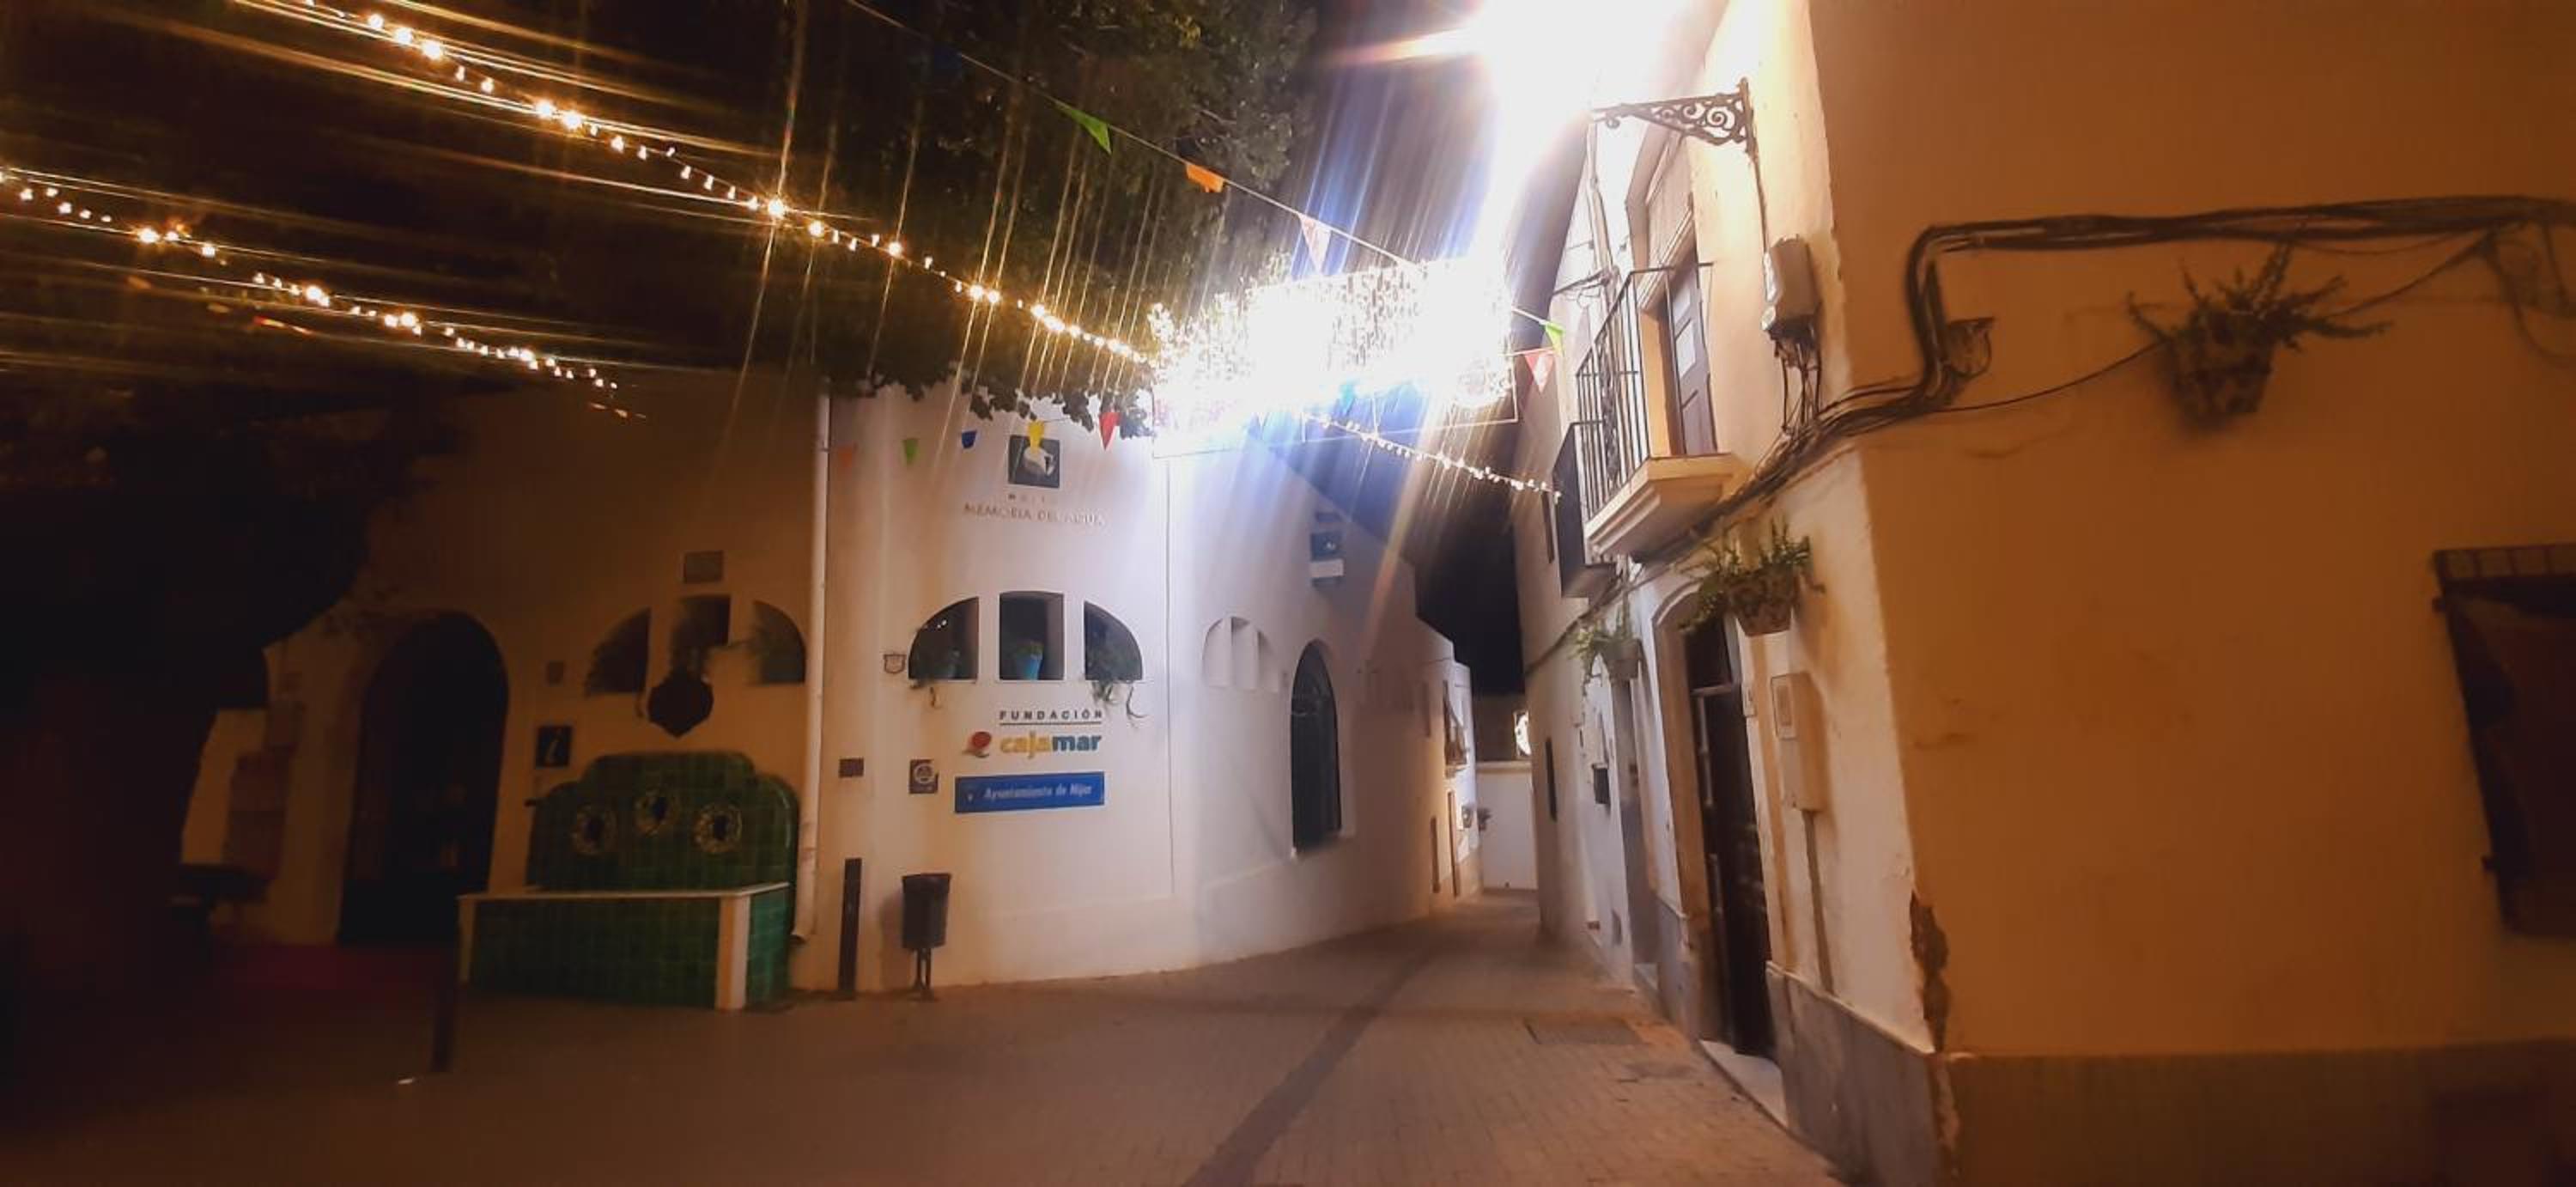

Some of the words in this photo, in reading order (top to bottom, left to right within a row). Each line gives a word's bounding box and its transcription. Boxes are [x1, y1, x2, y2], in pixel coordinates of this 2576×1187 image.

[999, 709, 1103, 721] FUNDACIÓN
[999, 731, 1103, 758] cajamar
[983, 785, 1053, 802] Ayuntamiento
[1055, 783, 1067, 797] de
